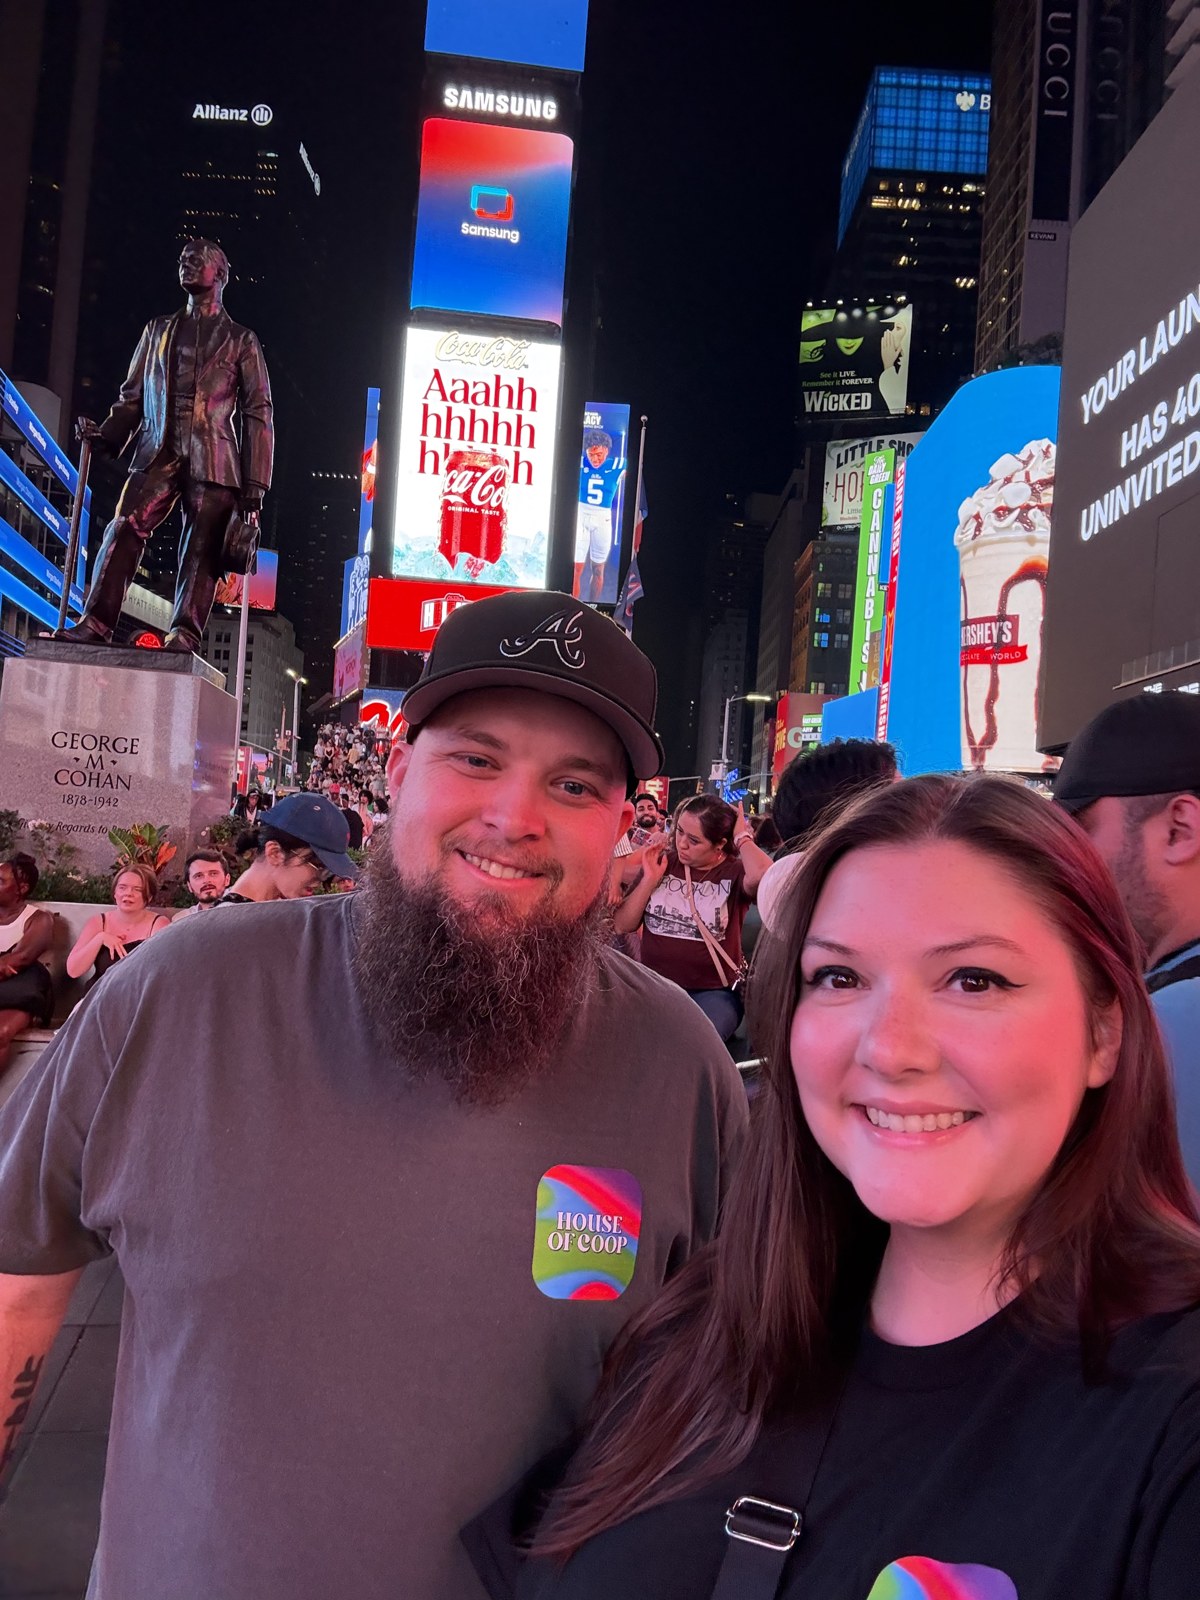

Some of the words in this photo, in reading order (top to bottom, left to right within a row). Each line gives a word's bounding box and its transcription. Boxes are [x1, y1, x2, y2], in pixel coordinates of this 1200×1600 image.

[192, 103, 248, 121] Allianz
[443, 86, 558, 120] SAMSUNG
[461, 222, 520, 244] Samsung
[435, 331, 533, 370] Coca-Cola
[422, 368, 538, 412] Aaahh
[1081, 349, 1135, 425] YOUR
[420, 403, 536, 449] hhhhh
[1120, 401, 1168, 468] HAS
[836, 439, 885, 469] LITTLE
[587, 478, 604, 505] 5
[1079, 430, 1200, 541] UNINVITED
[447, 505, 479, 514] ORIGINAL
[481, 508, 501, 516] TASTE
[861, 488, 883, 665] CANNABIS
[128, 594, 148, 611] HYATT
[990, 651, 1021, 661] WORLD
[51, 731, 140, 755] GEORGE
[54, 769, 132, 791] COHAN
[62, 794, 119, 809] 1878-1942
[55, 821, 95, 835] Regards
[97, 824, 108, 835] to
[557, 1211, 623, 1234] HOUSE
[547, 1231, 576, 1251] OF
[577, 1233, 628, 1254] COOP
